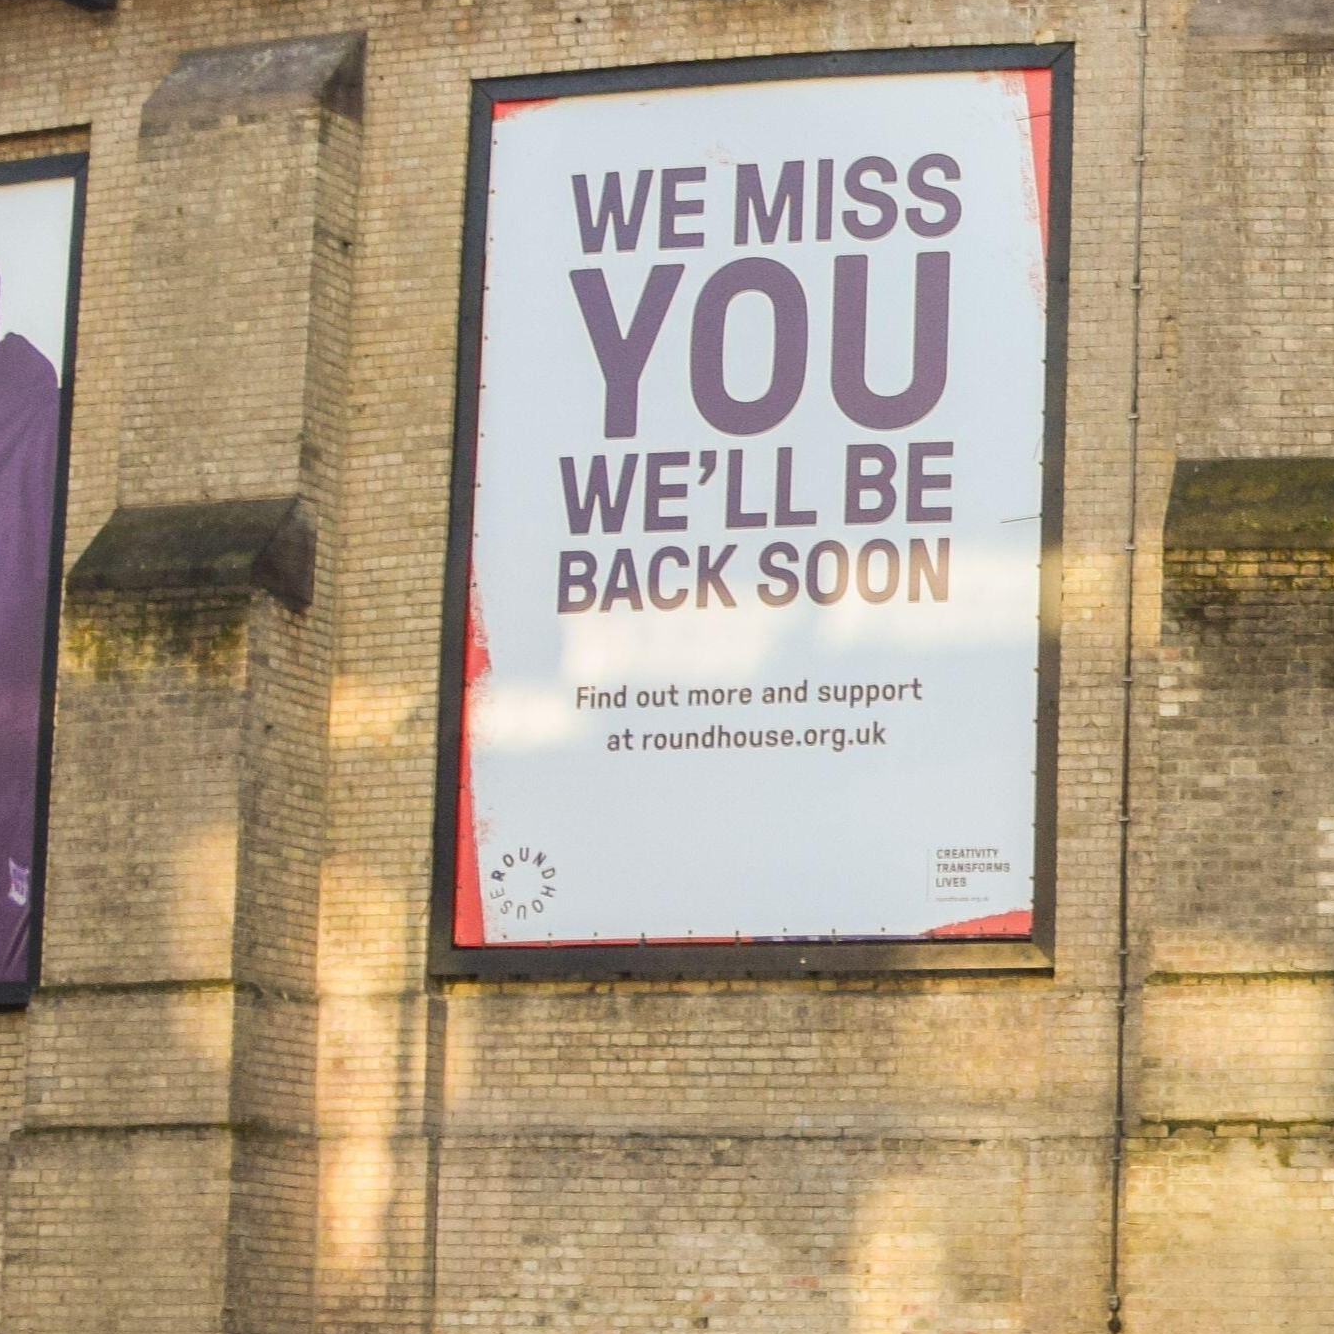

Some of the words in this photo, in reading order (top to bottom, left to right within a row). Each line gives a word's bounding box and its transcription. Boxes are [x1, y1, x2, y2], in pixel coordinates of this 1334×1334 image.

[572, 167, 706, 254] WE
[734, 153, 961, 246] MISS
[569, 251, 950, 439] YOU
[559, 447, 817, 535] WE'LL
[845, 442, 953, 525] BE
[557, 544, 737, 614] BACK
[757, 538, 950, 605] SOON
[577, 685, 626, 709] Find
[637, 685, 678, 708] out
[688, 688, 752, 706] more
[762, 680, 807, 704] and
[818, 678, 922, 708] support
[607, 729, 633, 751] at
[643, 721, 885, 752] roundhouse.org.uk
[936, 848, 998, 859] CREATIVITY
[936, 863, 1010, 874] TRANSFORMS
[490, 847, 556, 919] ROUNDHOUSE
[935, 877, 967, 888] LIVES
